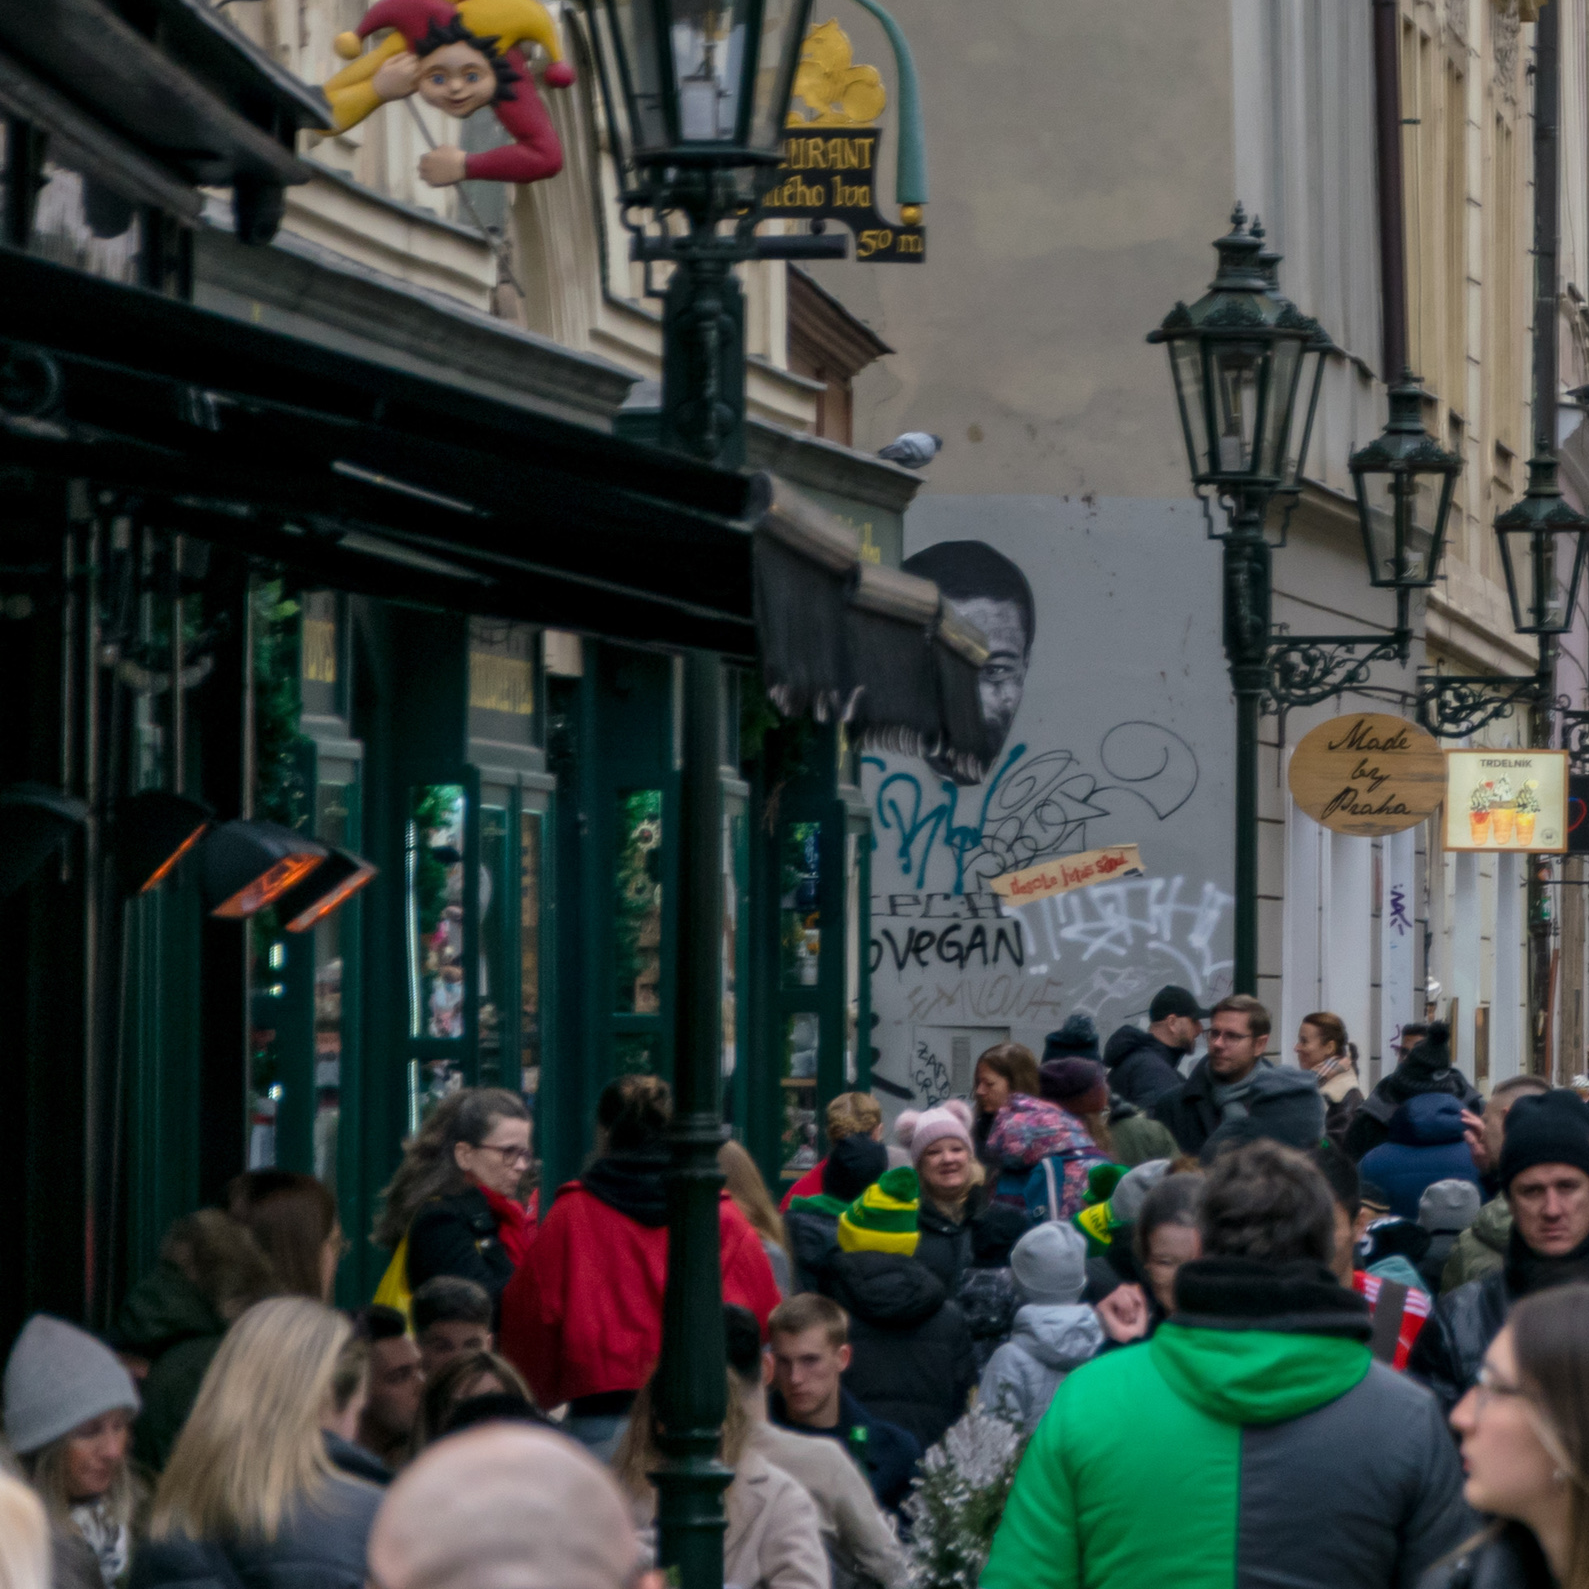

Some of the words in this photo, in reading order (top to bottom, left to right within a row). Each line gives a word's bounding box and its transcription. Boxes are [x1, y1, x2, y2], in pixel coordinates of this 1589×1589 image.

[777, 134, 875, 170] URANT
[1328, 718, 1412, 751] Made
[1350, 757, 1392, 793] by
[1320, 786, 1412, 820] Praha
